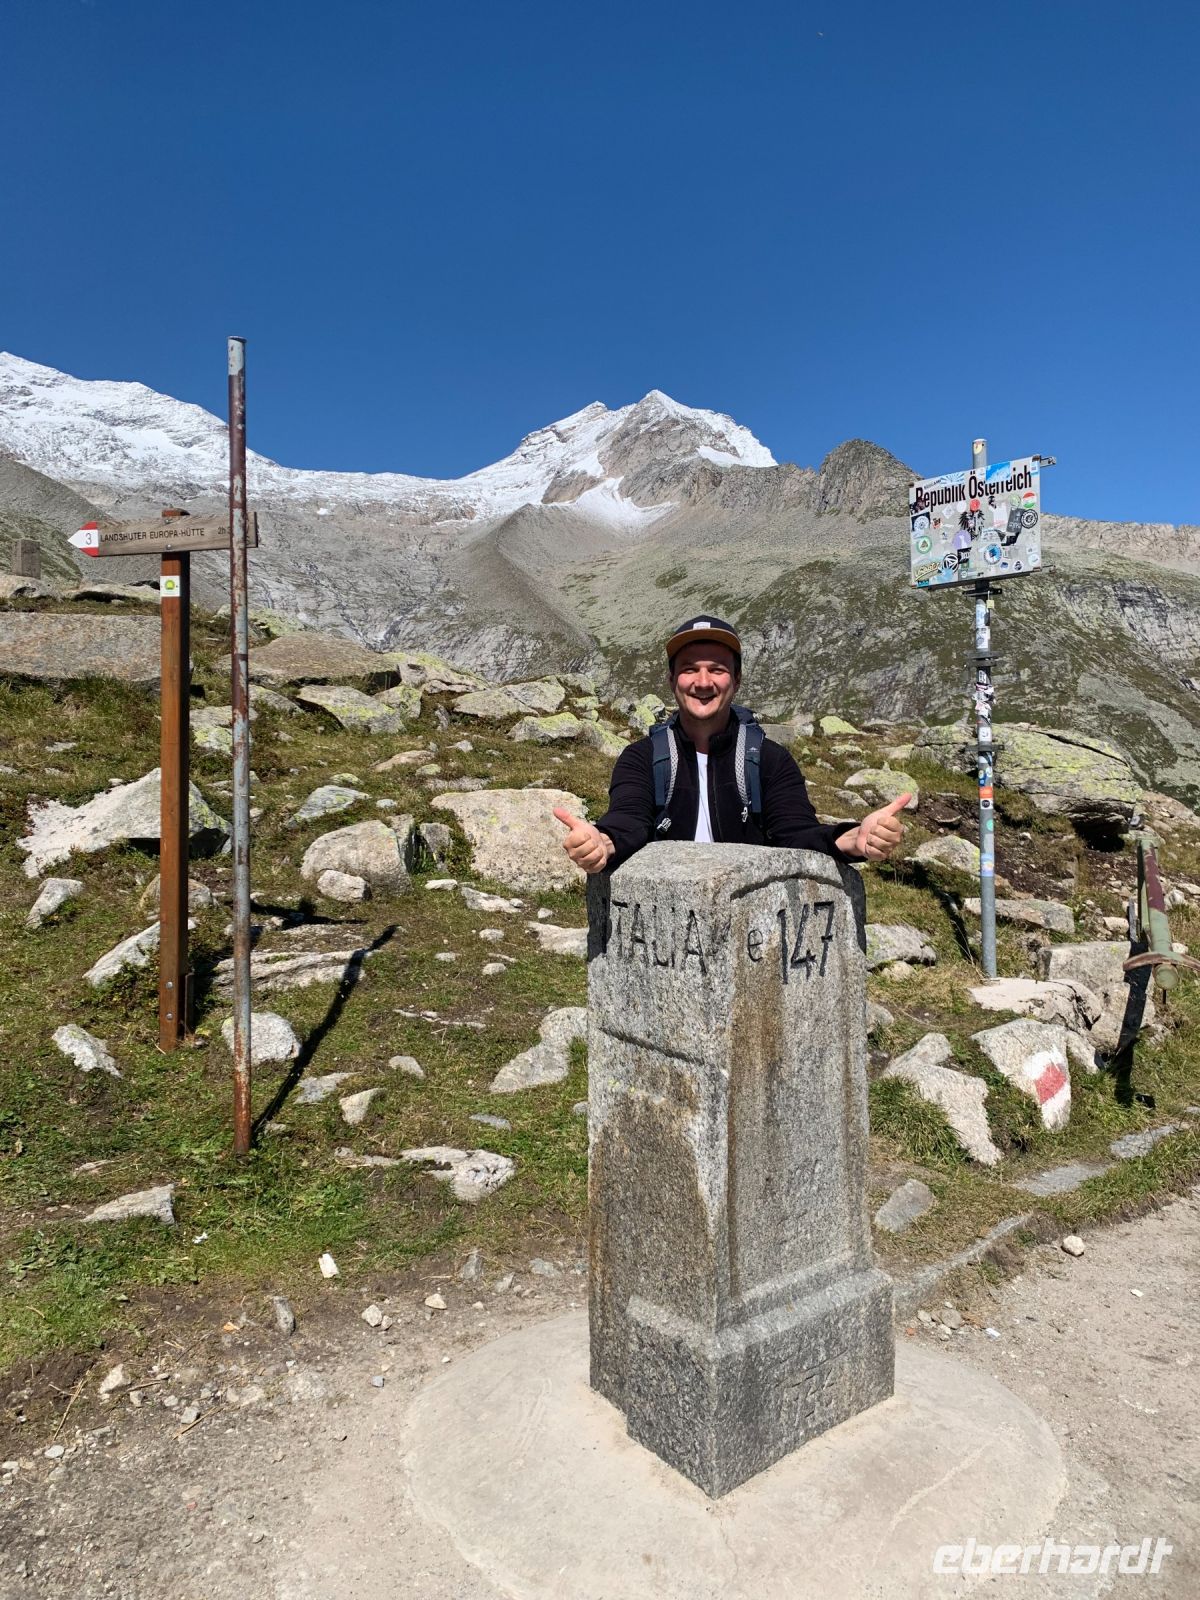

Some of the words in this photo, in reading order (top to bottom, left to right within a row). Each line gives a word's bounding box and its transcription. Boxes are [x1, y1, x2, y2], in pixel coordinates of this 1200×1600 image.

[916, 484, 966, 512] Republik
[85, 532, 92, 545] 3
[101, 532, 147, 543] LANDSHUTER
[150, 528, 205, 540] EUROPA-HÜTTE
[776, 900, 835, 985] 147
